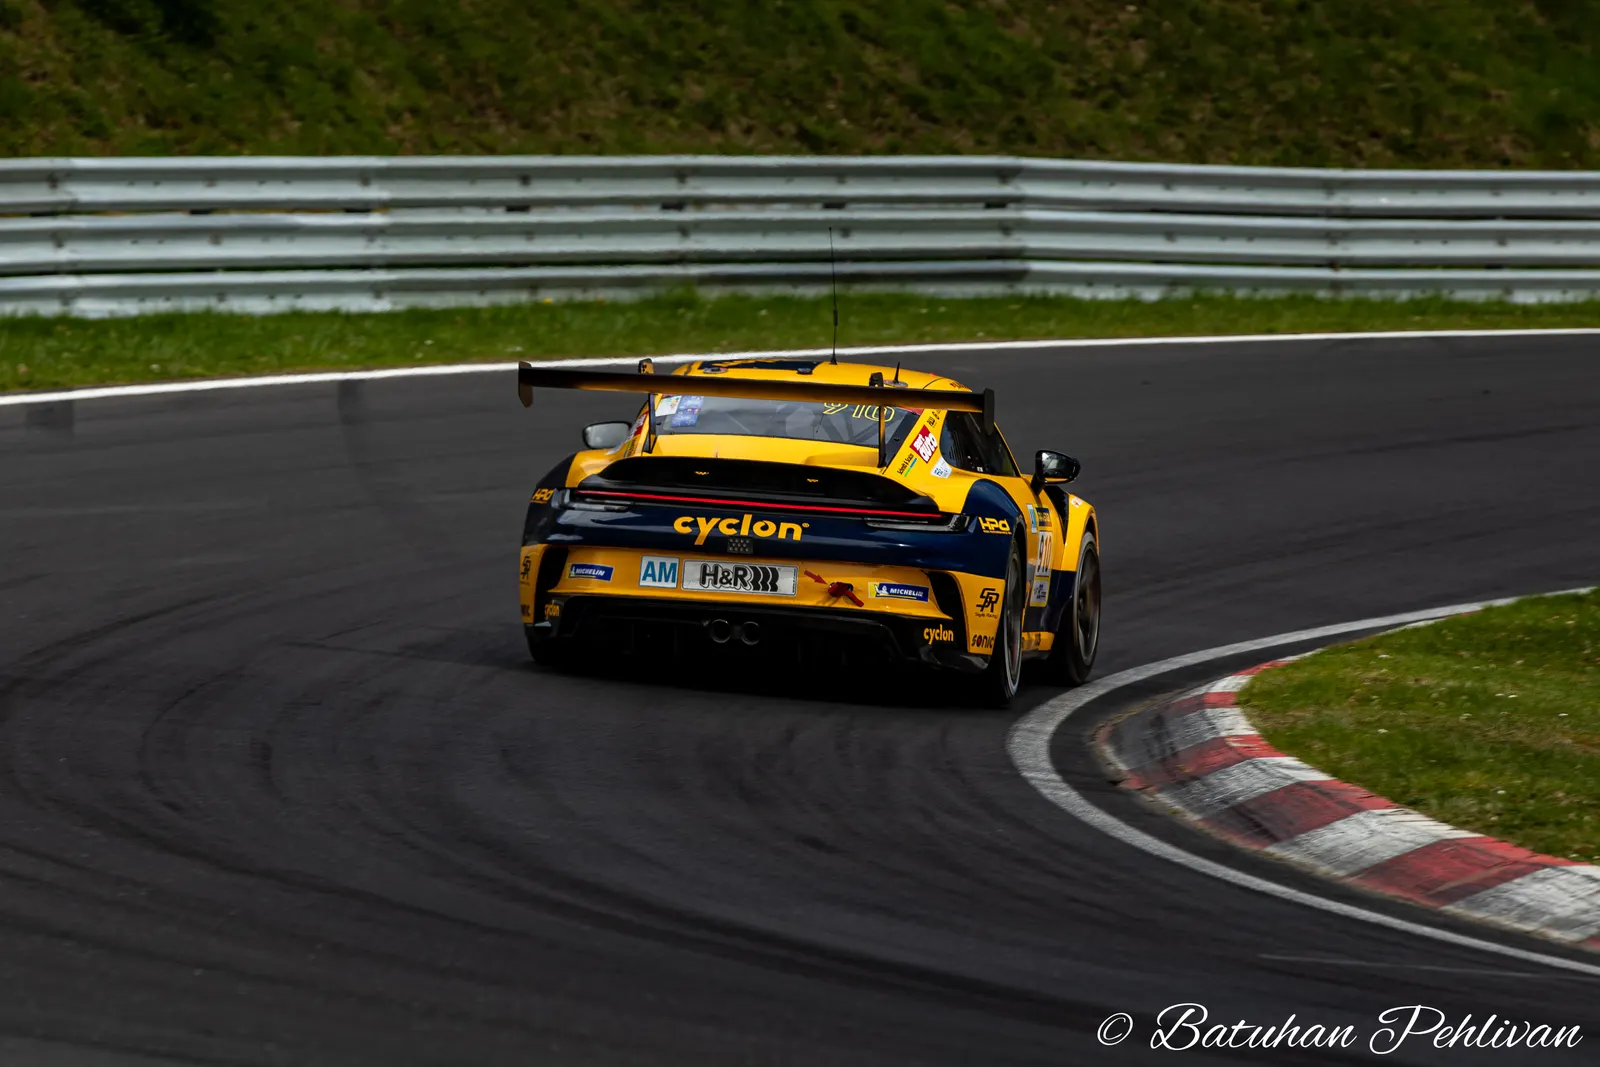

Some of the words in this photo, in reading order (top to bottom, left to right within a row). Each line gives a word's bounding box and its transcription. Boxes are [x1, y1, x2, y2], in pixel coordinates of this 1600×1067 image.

[641, 560, 678, 583] AM
[889, 587, 924, 598] MICHELIN
[923, 623, 954, 645] cyclon
